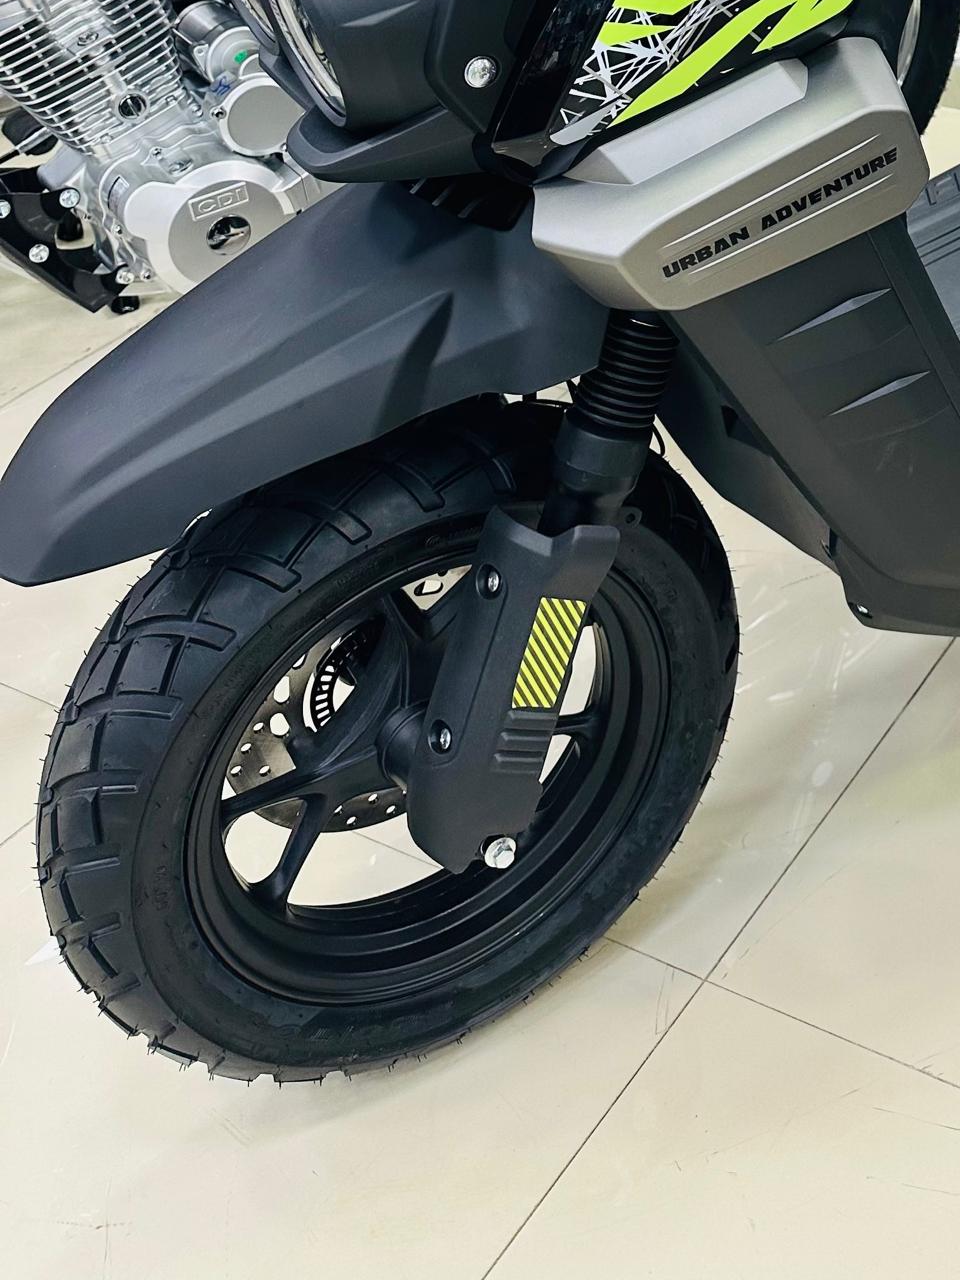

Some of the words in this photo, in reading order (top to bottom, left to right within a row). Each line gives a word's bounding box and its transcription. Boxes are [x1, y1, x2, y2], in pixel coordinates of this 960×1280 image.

[198, 189, 246, 214] CDI
[662, 226, 750, 278] URBAN
[761, 147, 897, 231] ADVENTURE
